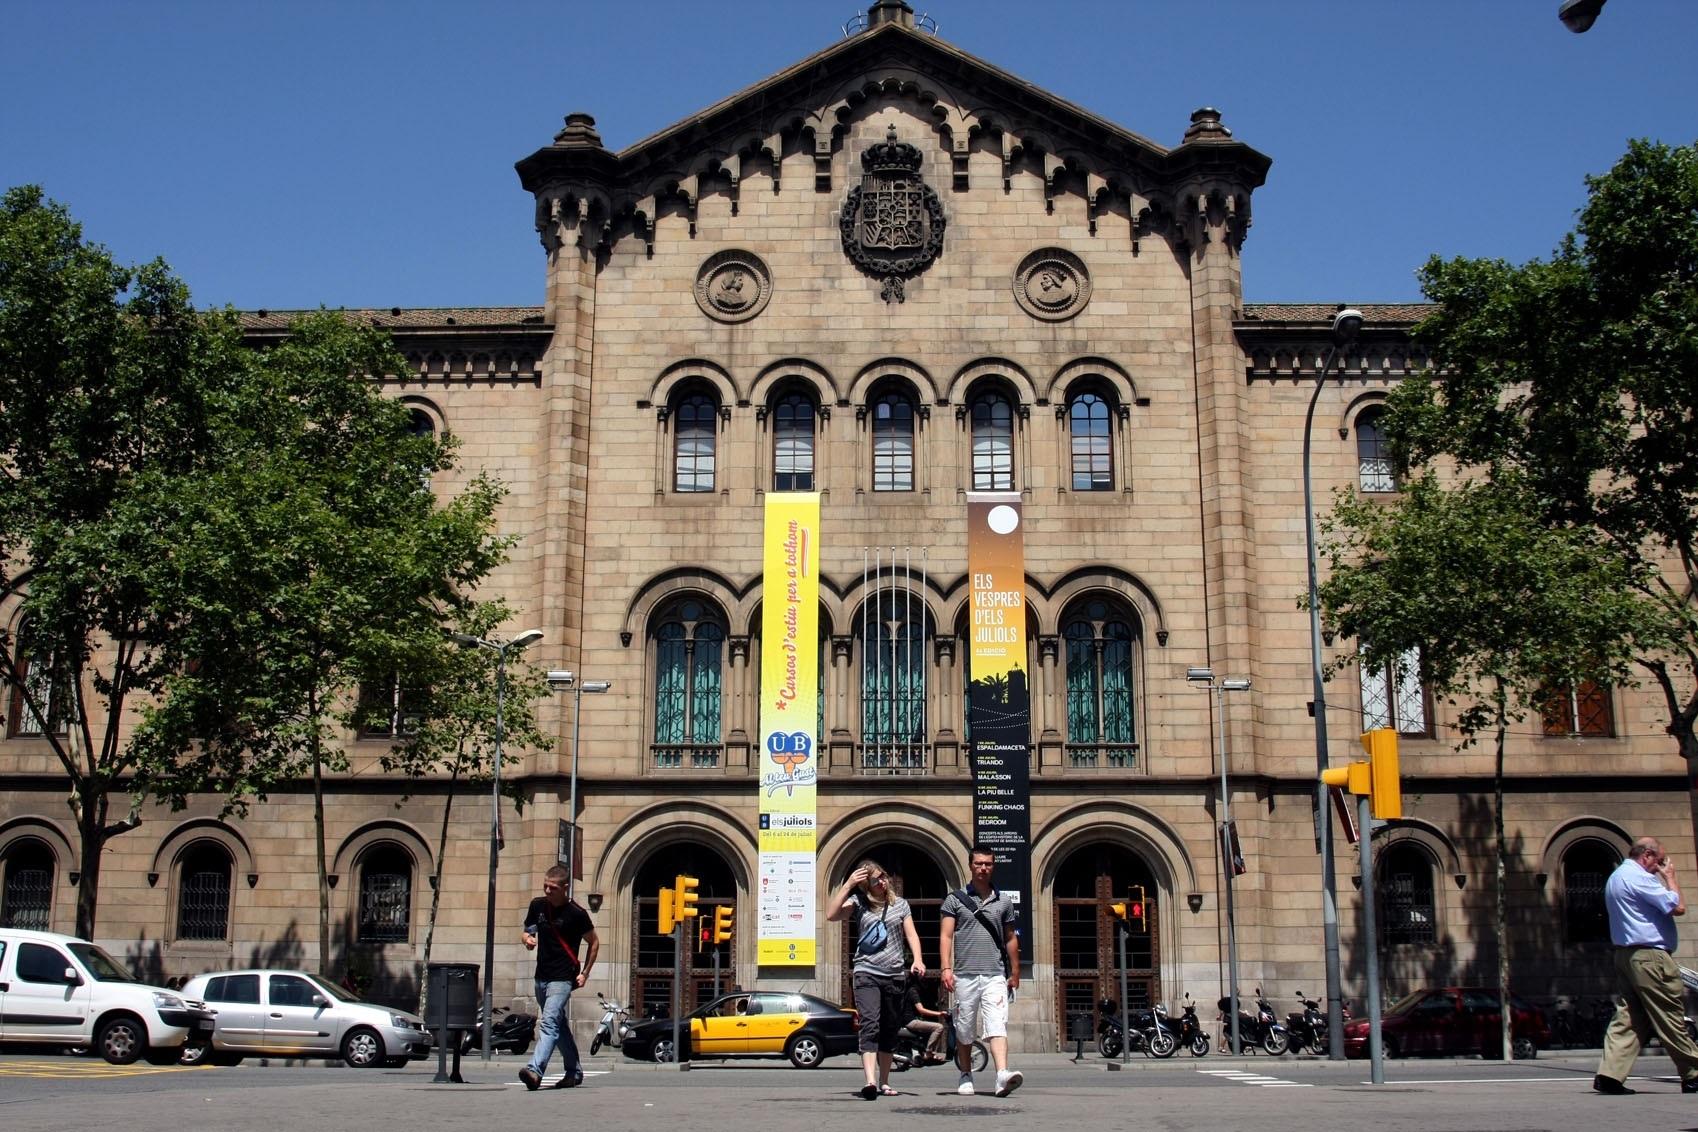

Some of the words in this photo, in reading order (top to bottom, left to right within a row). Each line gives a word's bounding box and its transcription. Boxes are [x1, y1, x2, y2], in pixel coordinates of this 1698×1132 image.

[783, 520, 798, 566] tothom
[787, 568, 797, 578] a
[974, 573, 993, 590] ELS
[787, 582, 801, 603] per
[974, 591, 1021, 608] VESPRES
[975, 609, 1003, 625] D'ELS
[976, 627, 1017, 643] JULIOLS
[780, 655, 797, 700] Cursos
